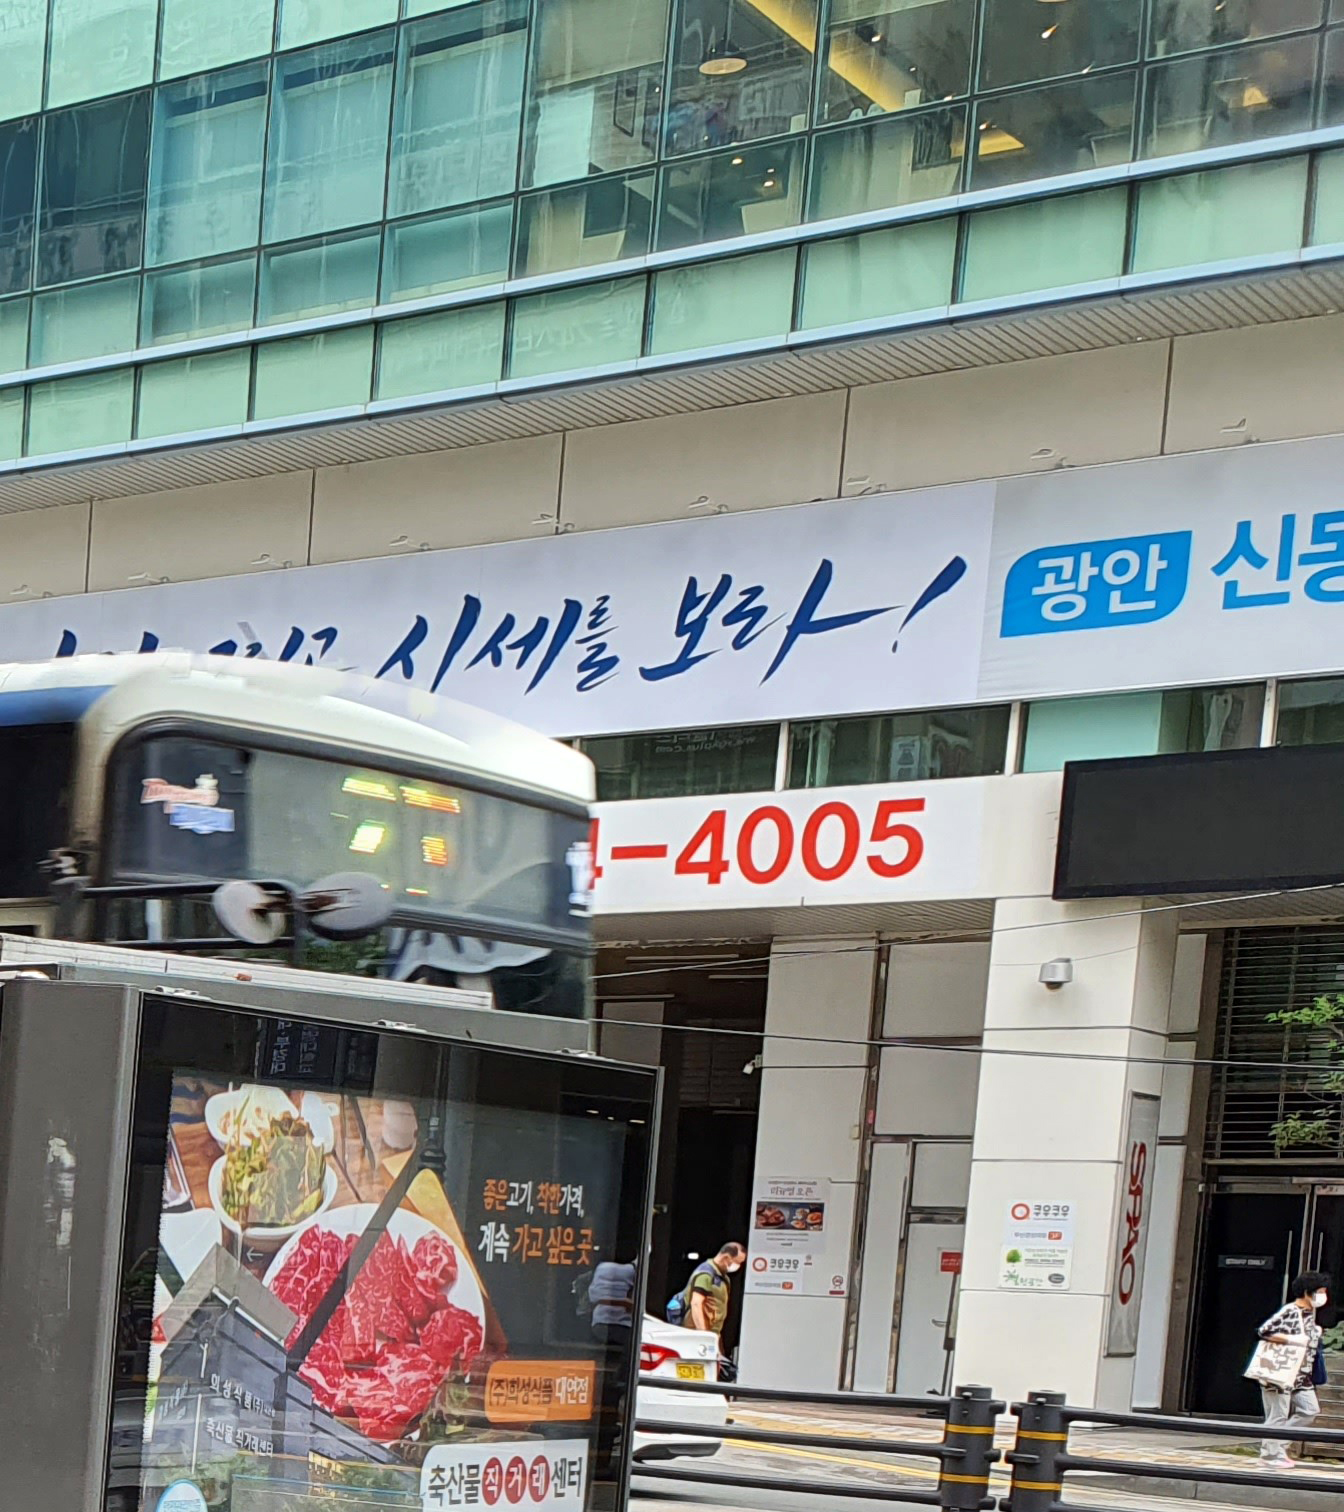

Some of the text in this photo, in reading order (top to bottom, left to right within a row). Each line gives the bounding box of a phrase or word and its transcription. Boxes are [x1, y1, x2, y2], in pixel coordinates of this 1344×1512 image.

[1031, 543, 1168, 623] 광안
[638, 554, 968, 686] 보라!
[482, 1178, 585, 1218] 좋은고기, 착한가격,
[1118, 1141, 1148, 1306] SPAO
[477, 1221, 576, 1265] 계속 가고 싶은
[555, 1375, 590, 1405] 대연점
[427, 1454, 584, 1508] 축산물직거래센터
